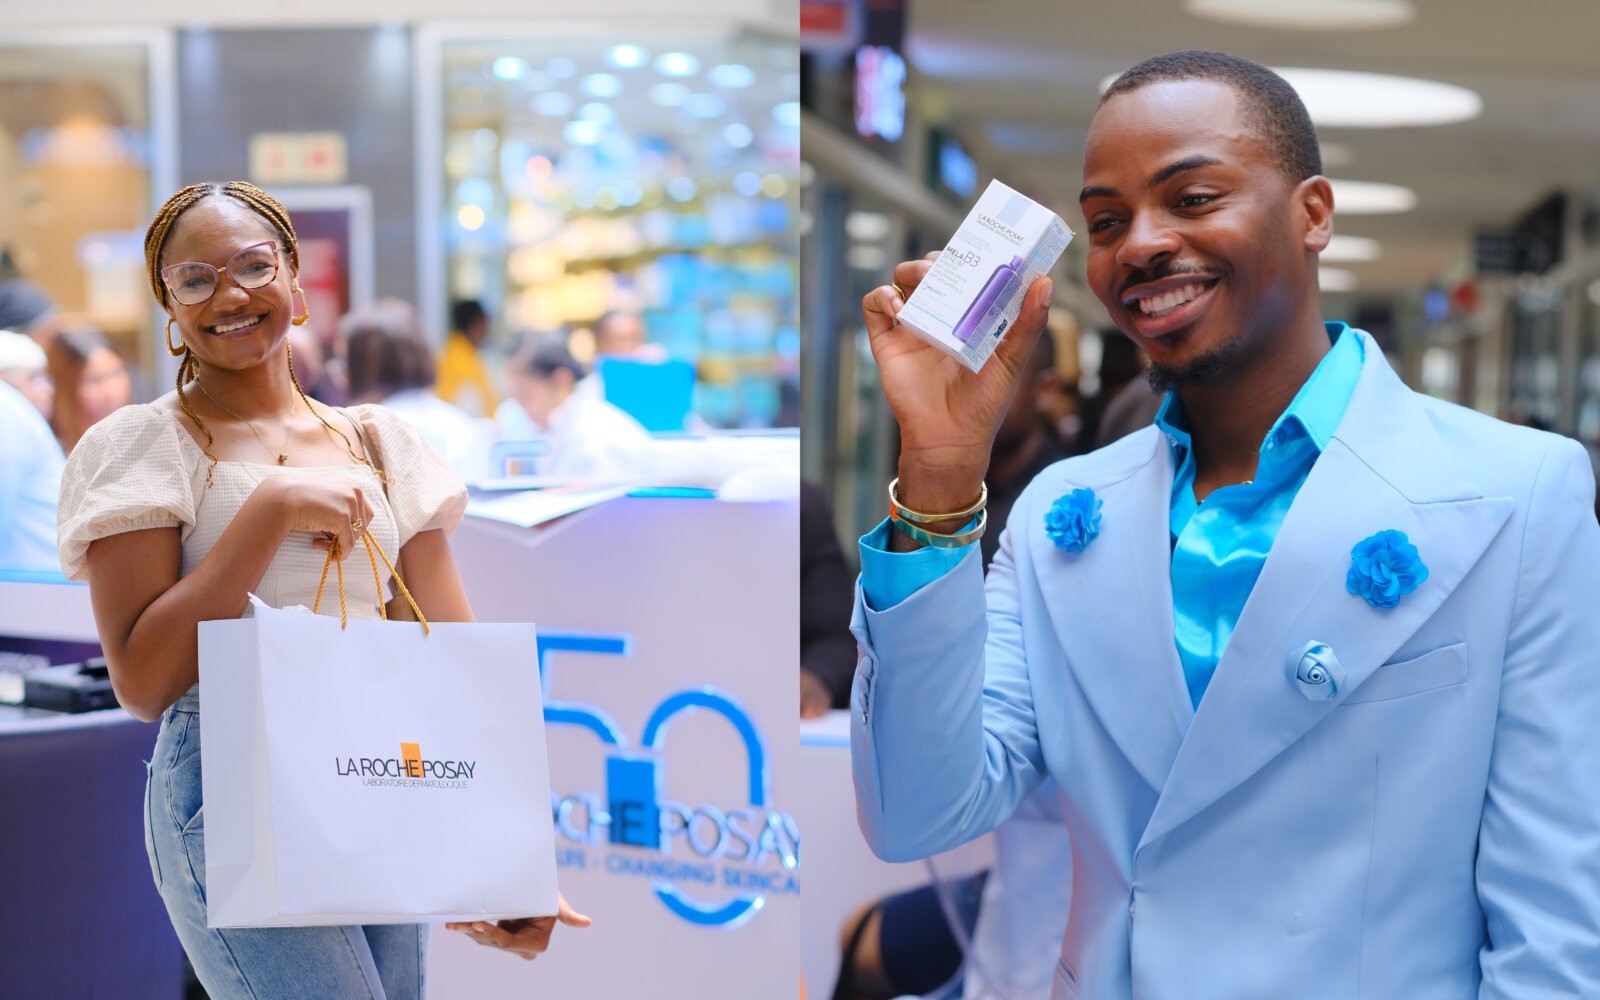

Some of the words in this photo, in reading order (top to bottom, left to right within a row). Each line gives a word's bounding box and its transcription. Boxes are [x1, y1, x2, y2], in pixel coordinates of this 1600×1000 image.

[946, 246, 965, 260] MELA
[962, 250, 982, 269] B3
[335, 756, 360, 777] LA
[360, 757, 420, 778] ROCHE
[422, 760, 476, 779] POSAY
[362, 778, 409, 788] LABORATOIRE
[409, 778, 469, 789] DERMATOLOGIQUE
[550, 794, 646, 848] CHE
